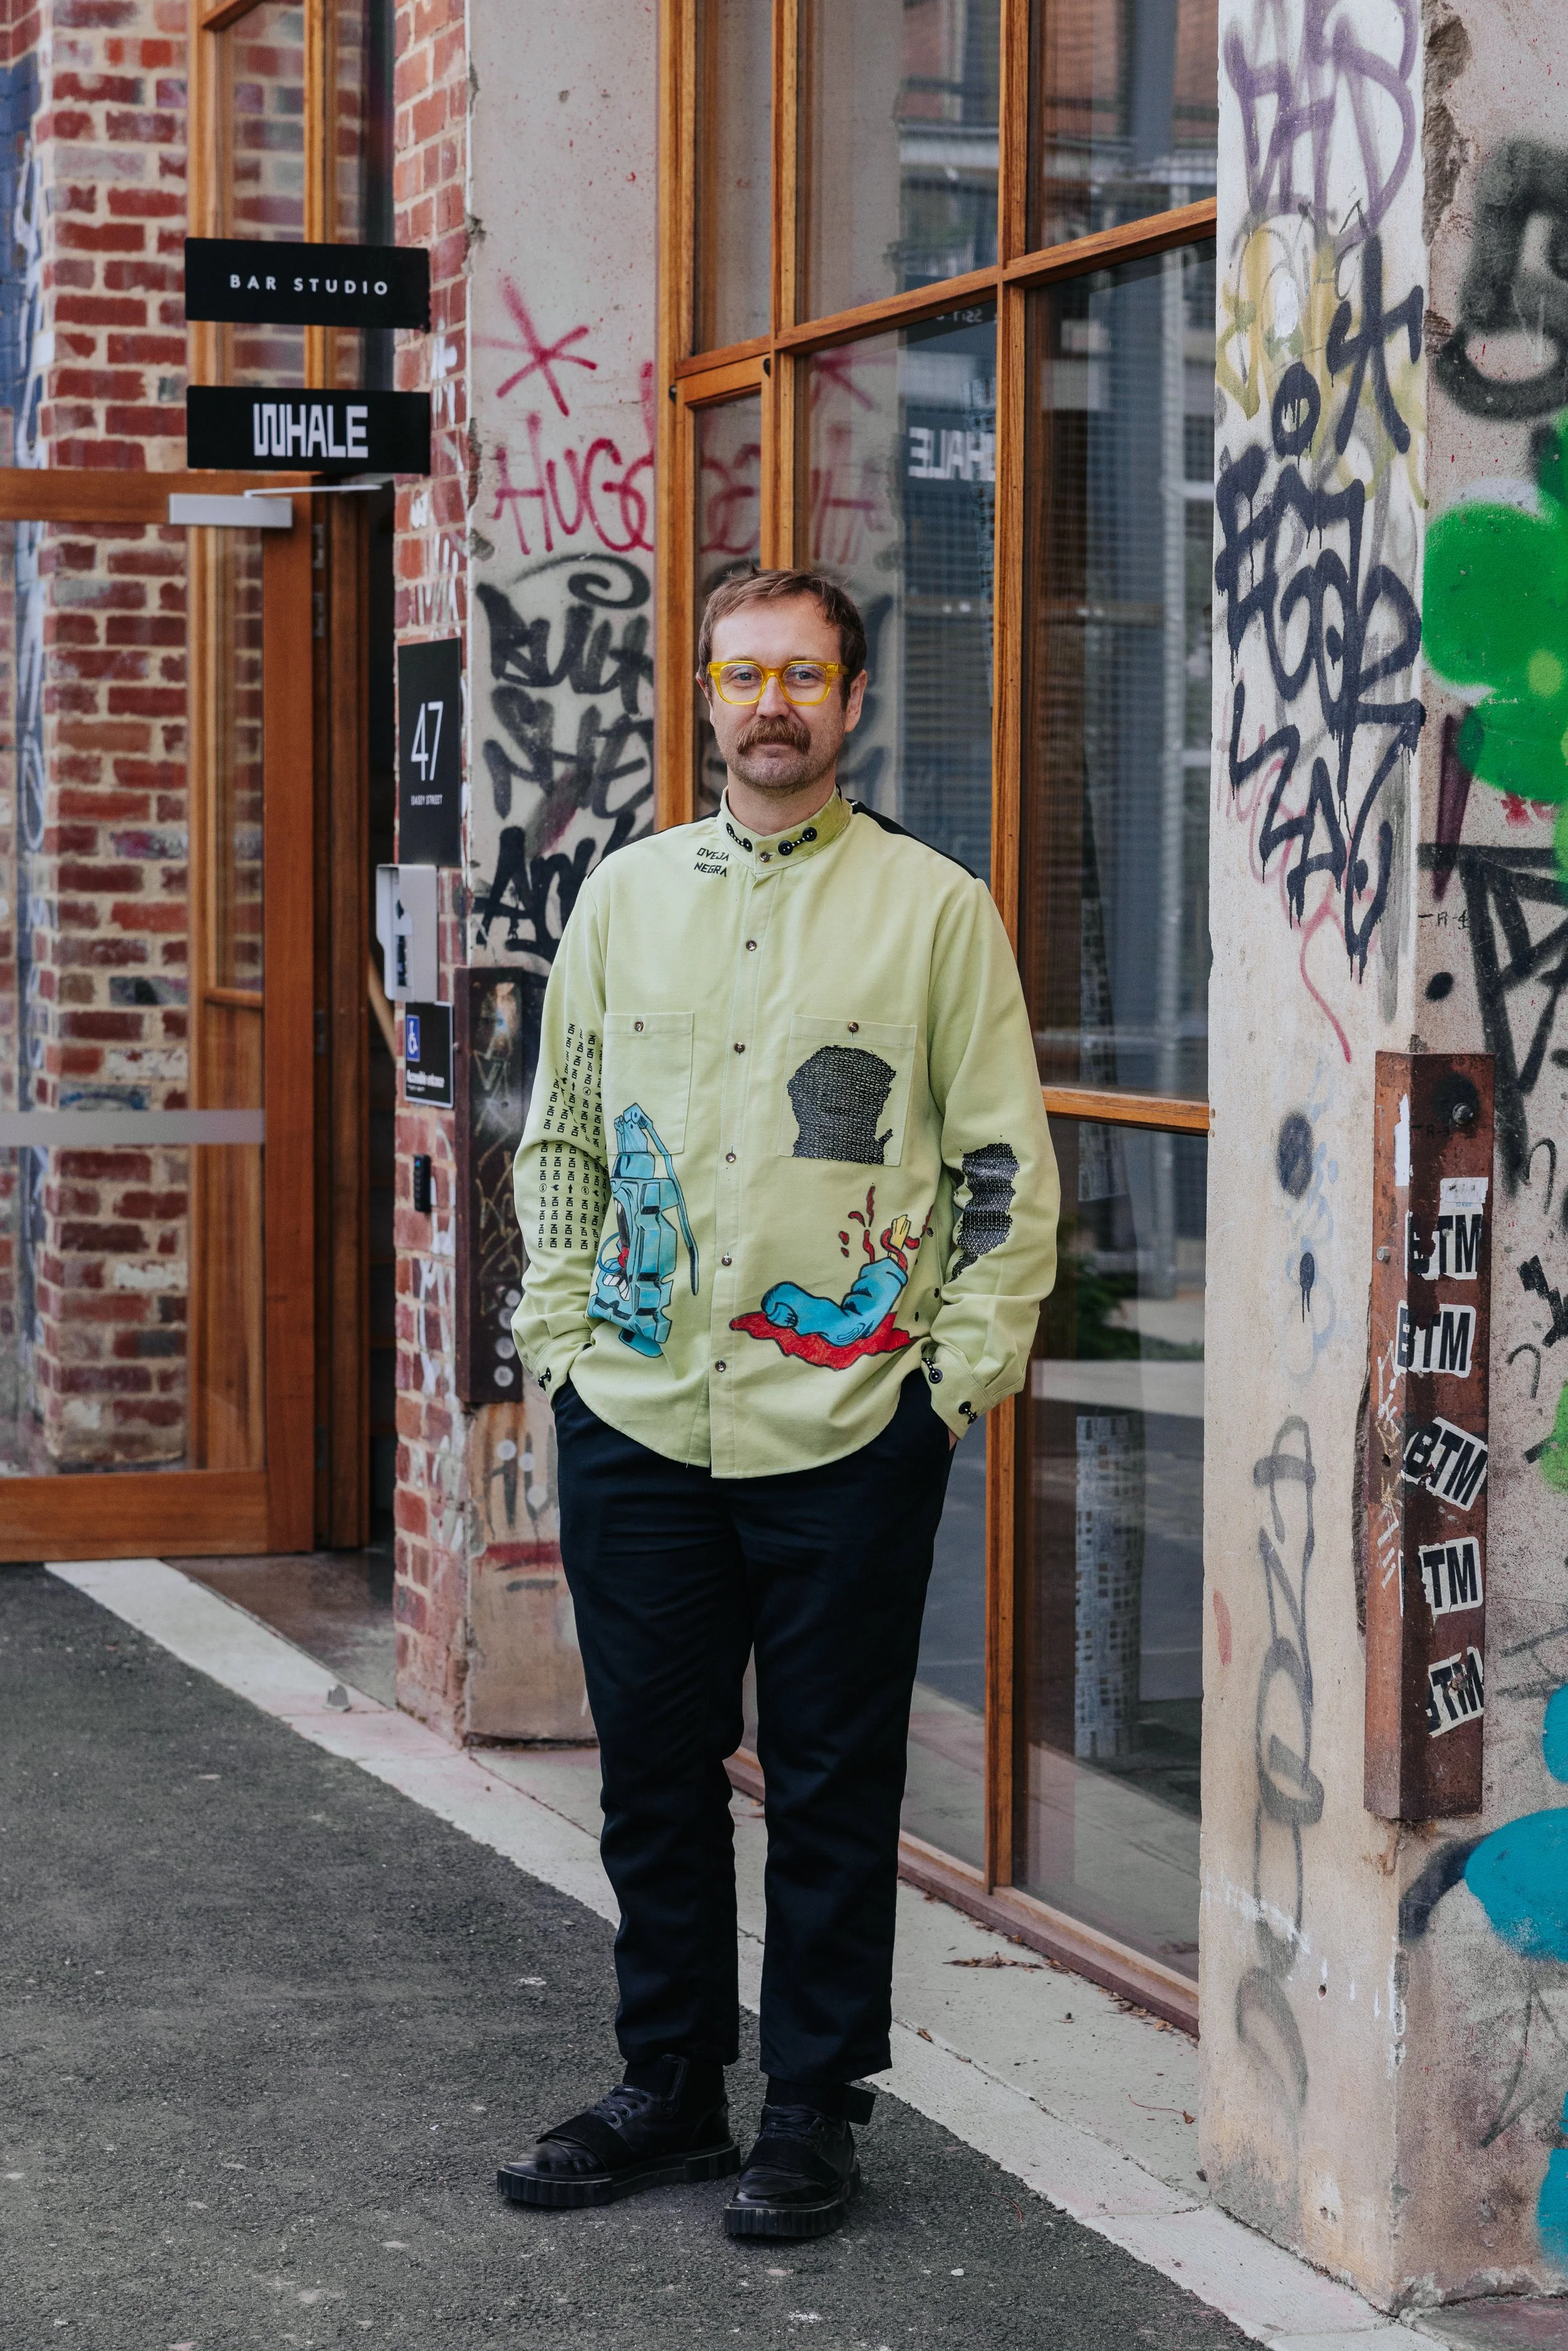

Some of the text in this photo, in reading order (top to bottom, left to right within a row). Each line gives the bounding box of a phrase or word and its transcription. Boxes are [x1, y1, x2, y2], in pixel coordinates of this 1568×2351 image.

[230, 273, 389, 295] BAR STUDIO
[253, 403, 369, 459] WHALE
[410, 701, 444, 781] 47
[694, 862, 727, 878] NEGRA
[696, 847, 729, 861] OVEJA
[1406, 1421, 1488, 1506] BTM
[1421, 1543, 1478, 1608] TM
